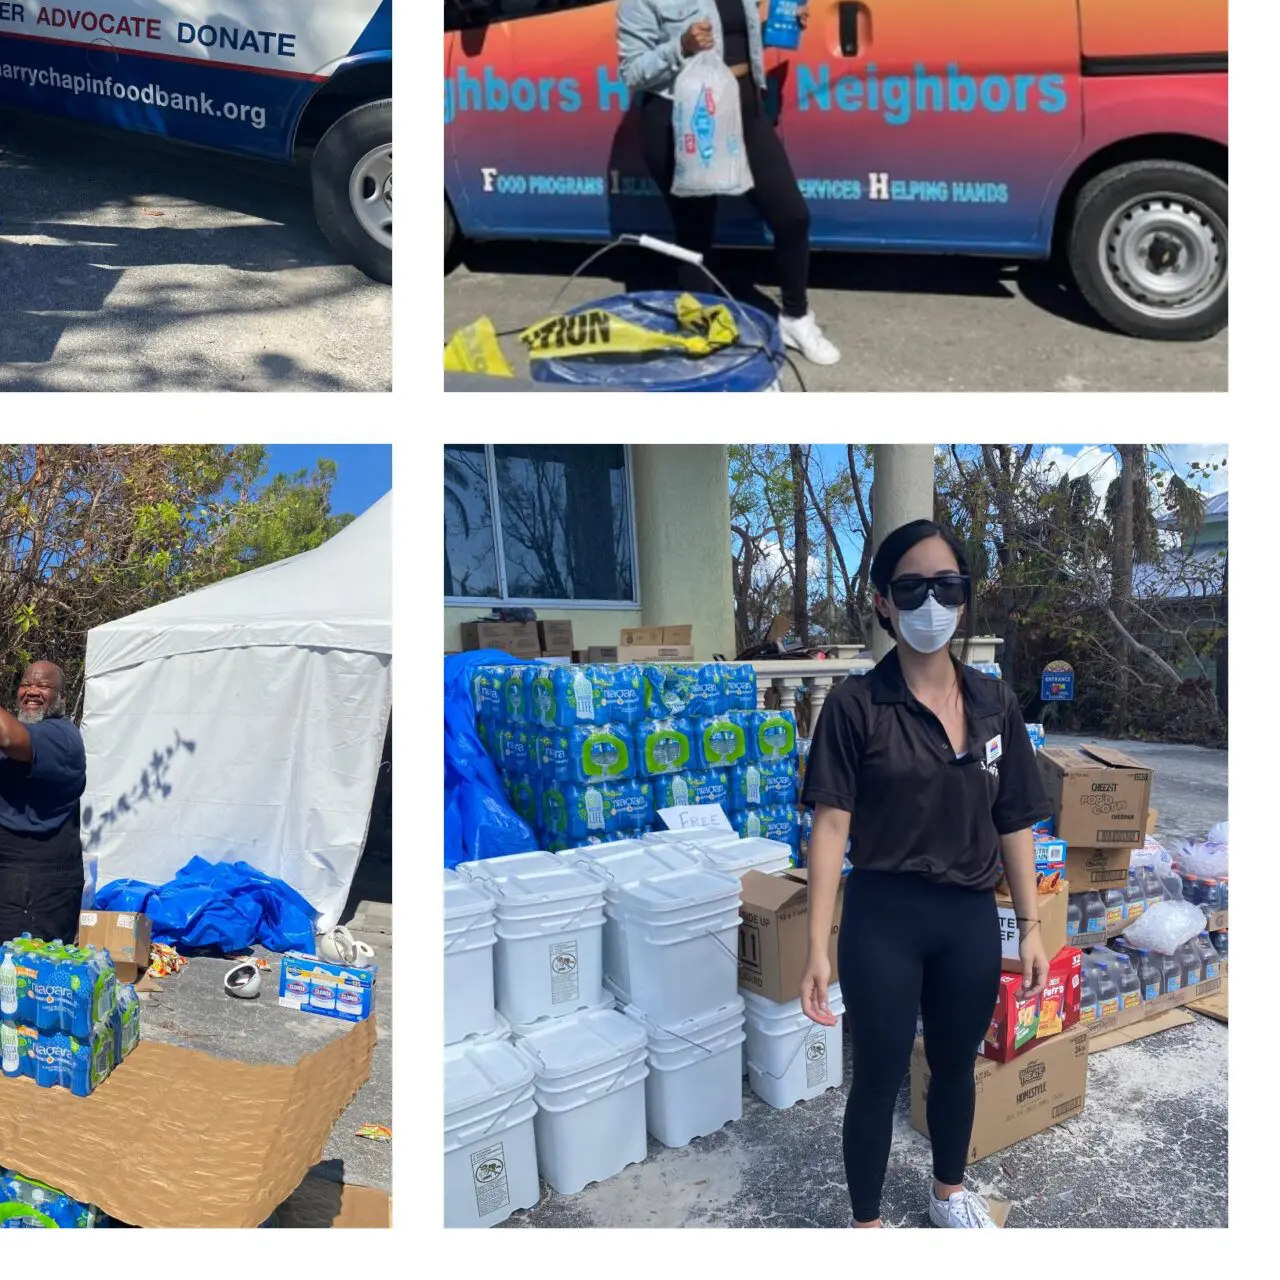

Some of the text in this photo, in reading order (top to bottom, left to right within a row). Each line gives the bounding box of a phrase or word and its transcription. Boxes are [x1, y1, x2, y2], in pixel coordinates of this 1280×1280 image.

[36, 6, 163, 41] ADVOCATE
[177, 21, 297, 58] DONATE
[796, 65, 1068, 127] Neighbors
[529, 174, 604, 196] PROGRAMS
[952, 181, 1008, 204] HANDS
[523, 311, 610, 350] TION
[679, 810, 721, 829] FREE
[1072, 954, 1081, 965] 32
[31, 982, 73, 999] niagara
[1016, 1081, 1047, 1104] HOMESTYLE
